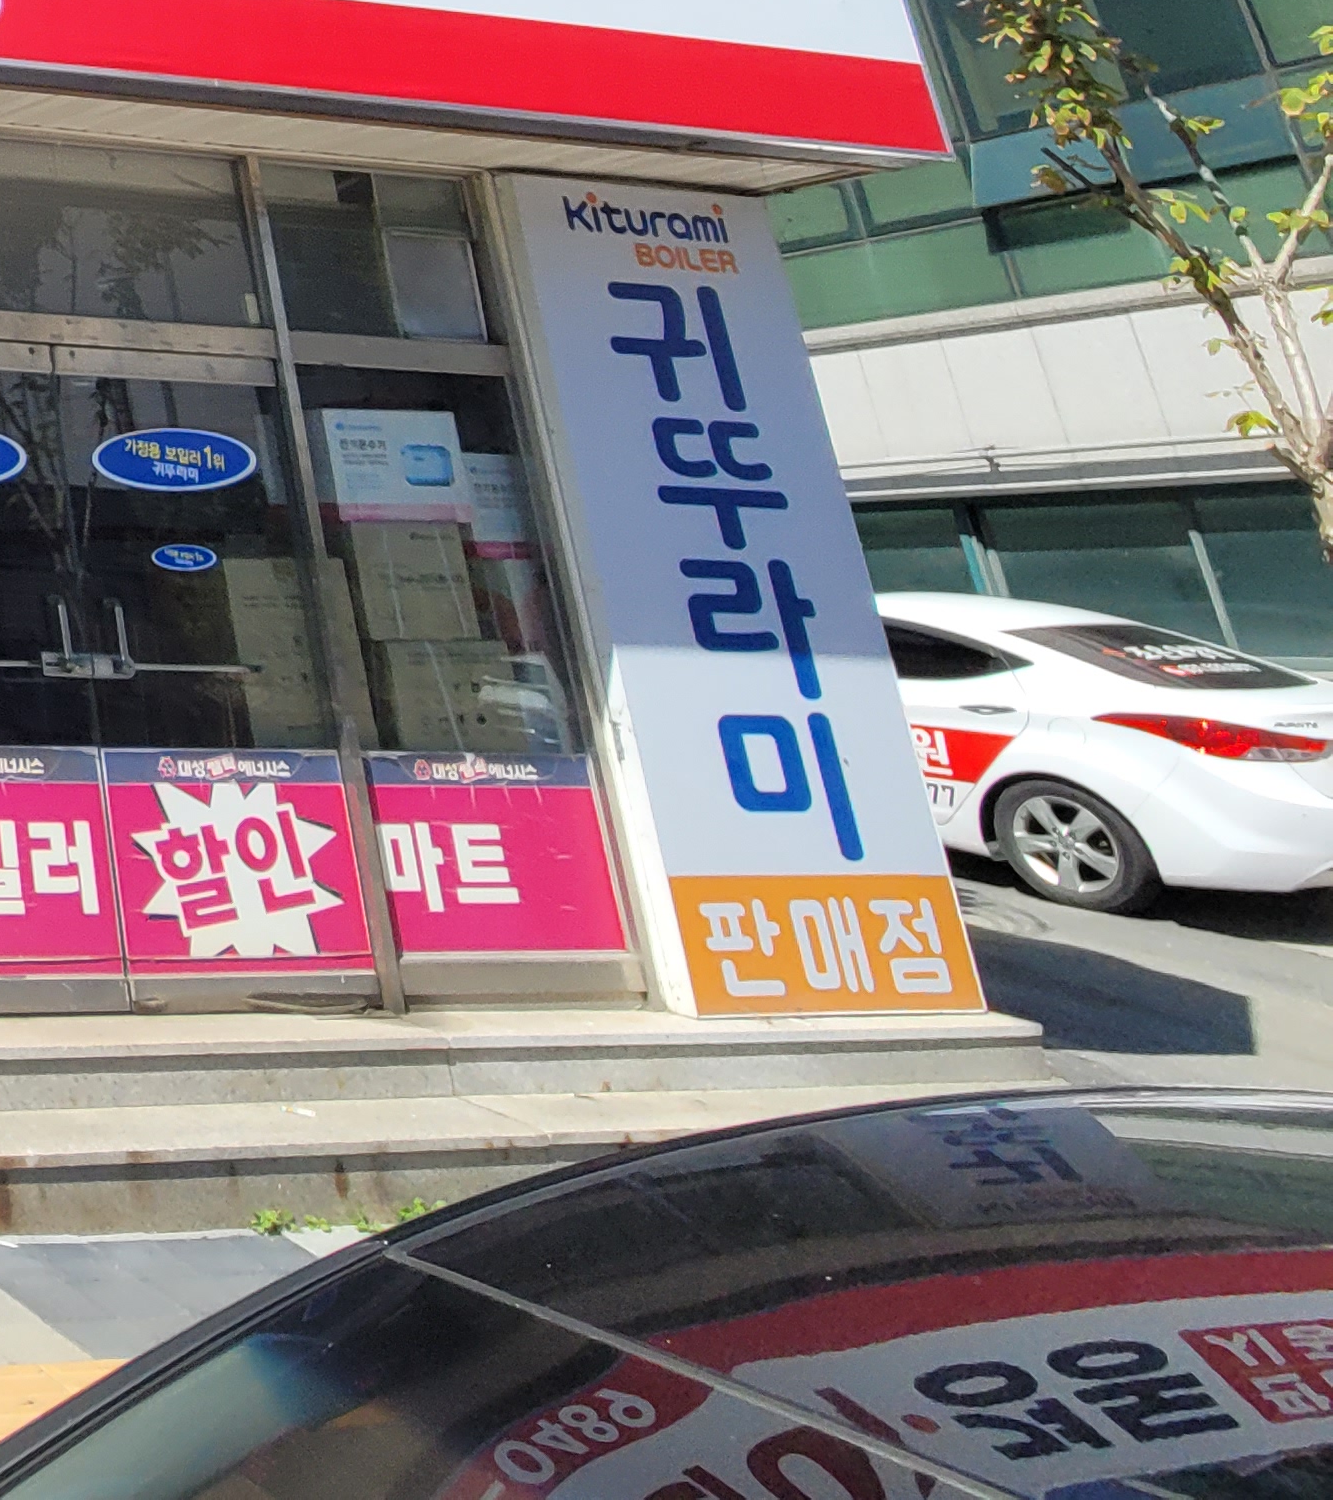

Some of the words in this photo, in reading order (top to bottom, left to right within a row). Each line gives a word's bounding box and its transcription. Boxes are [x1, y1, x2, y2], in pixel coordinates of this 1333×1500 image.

[561, 191, 730, 244] Kiturami
[633, 243, 740, 275] BOILER
[609, 281, 865, 861] 귀뚜라미
[154, 799, 320, 931] 할인
[383, 821, 520, 913] 마트
[699, 898, 954, 997] 판매점
